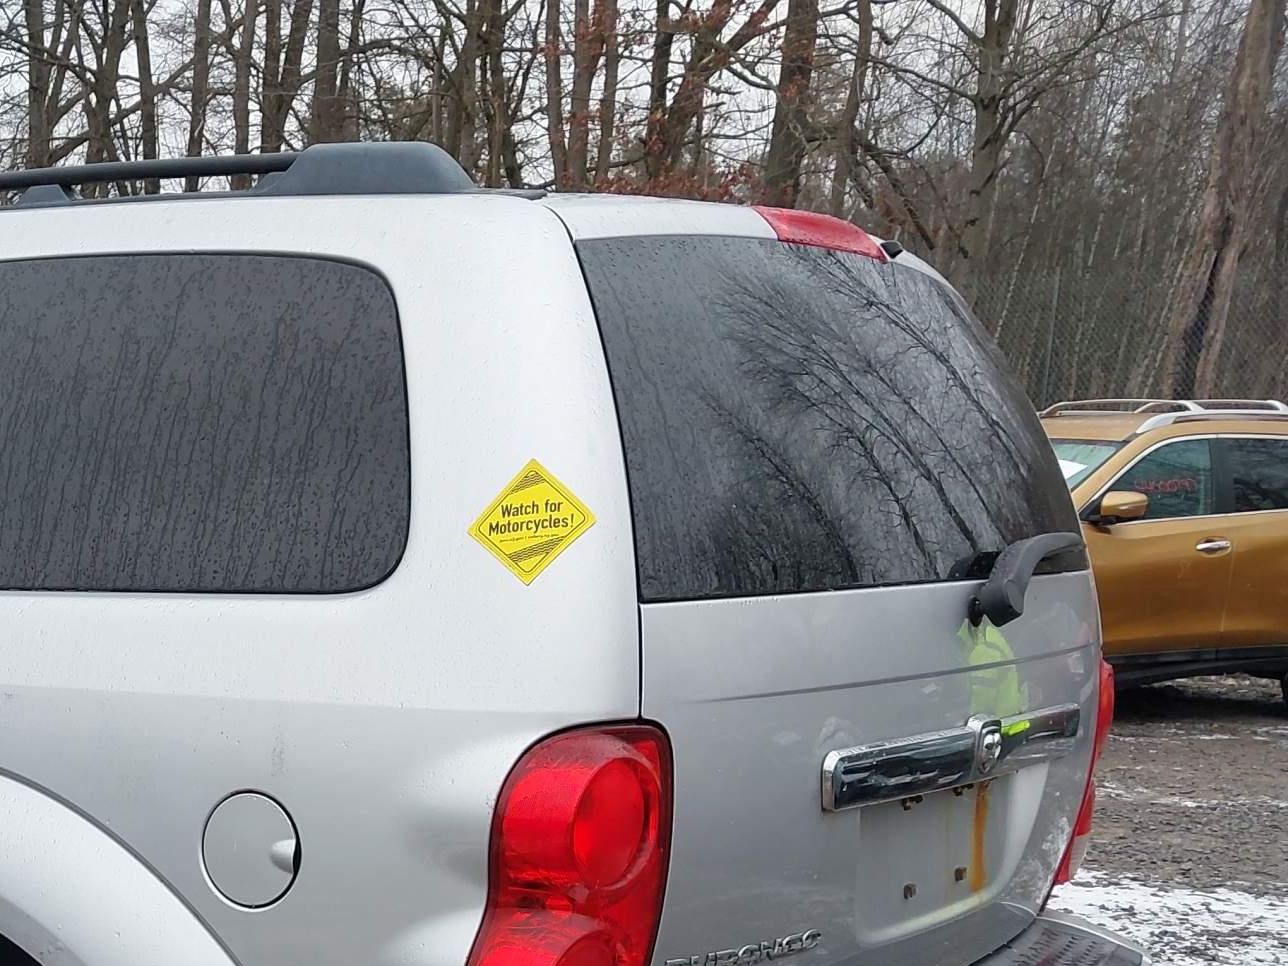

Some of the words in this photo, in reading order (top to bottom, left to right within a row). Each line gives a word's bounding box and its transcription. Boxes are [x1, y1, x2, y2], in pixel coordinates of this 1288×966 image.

[500, 501, 539, 518] Watch
[544, 499, 563, 513] for
[488, 514, 574, 536] Motorcycles!
